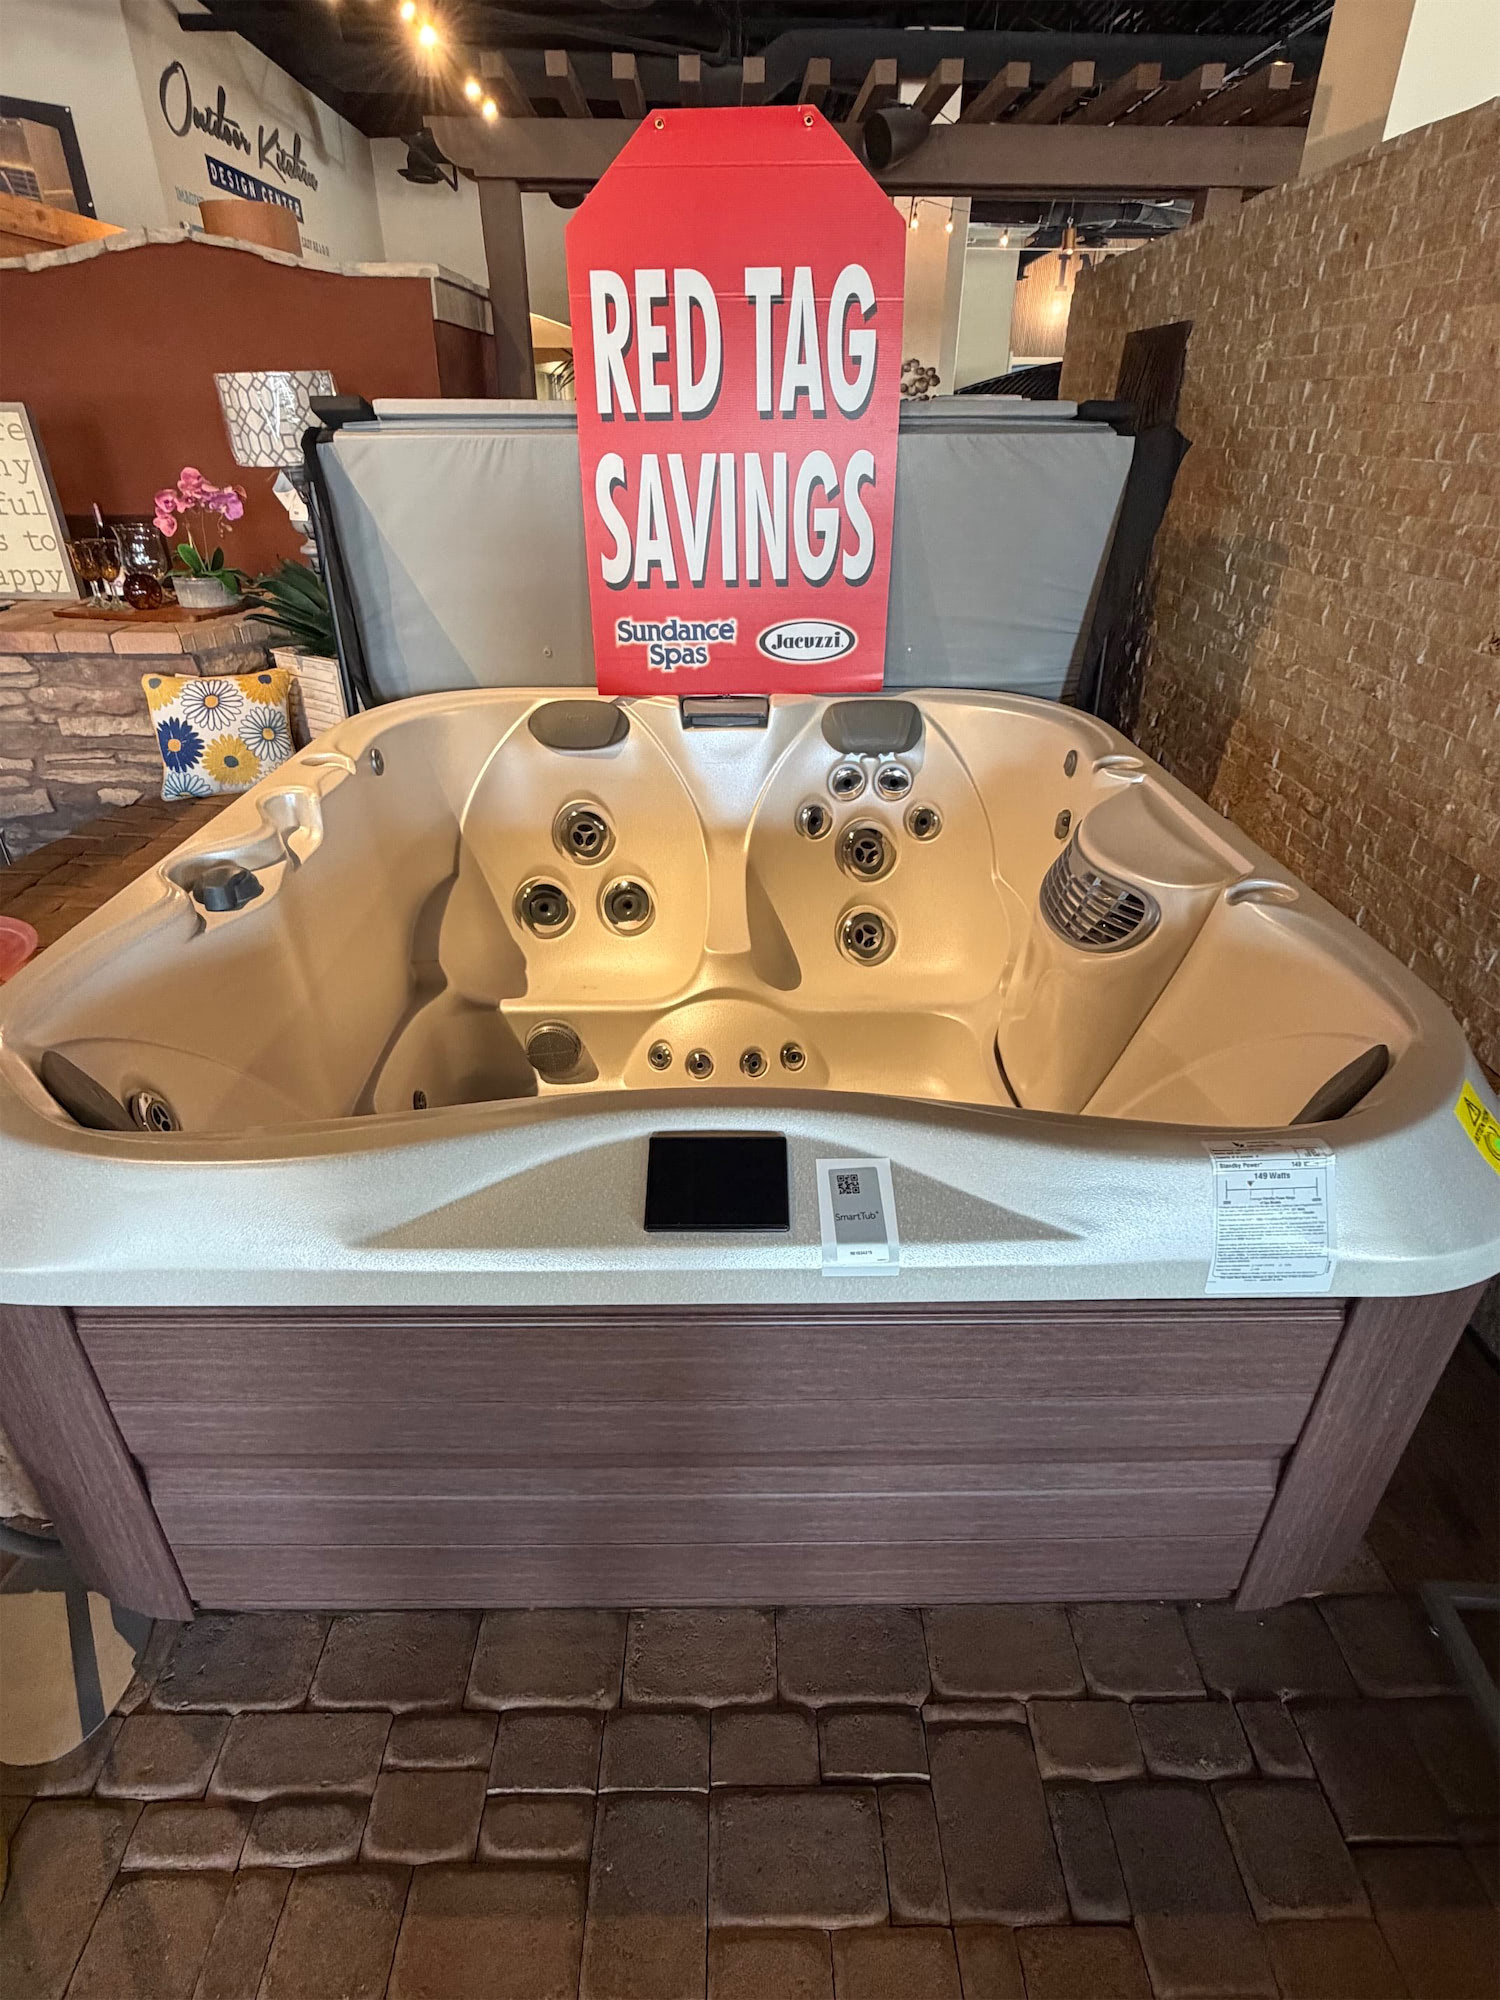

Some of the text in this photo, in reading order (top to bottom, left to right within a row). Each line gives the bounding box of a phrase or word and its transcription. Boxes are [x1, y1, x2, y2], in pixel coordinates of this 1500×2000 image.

[159, 60, 251, 156] Outdoor
[210, 161, 256, 198] DESIGN
[261, 185, 301, 218] CENTER
[589, 263, 877, 420] RED TAG
[22, 530, 57, 551] to
[595, 449, 876, 590] SAVINGS
[650, 644, 708, 670] Spas
[1254, 1172, 1291, 1180] 149 Watts
